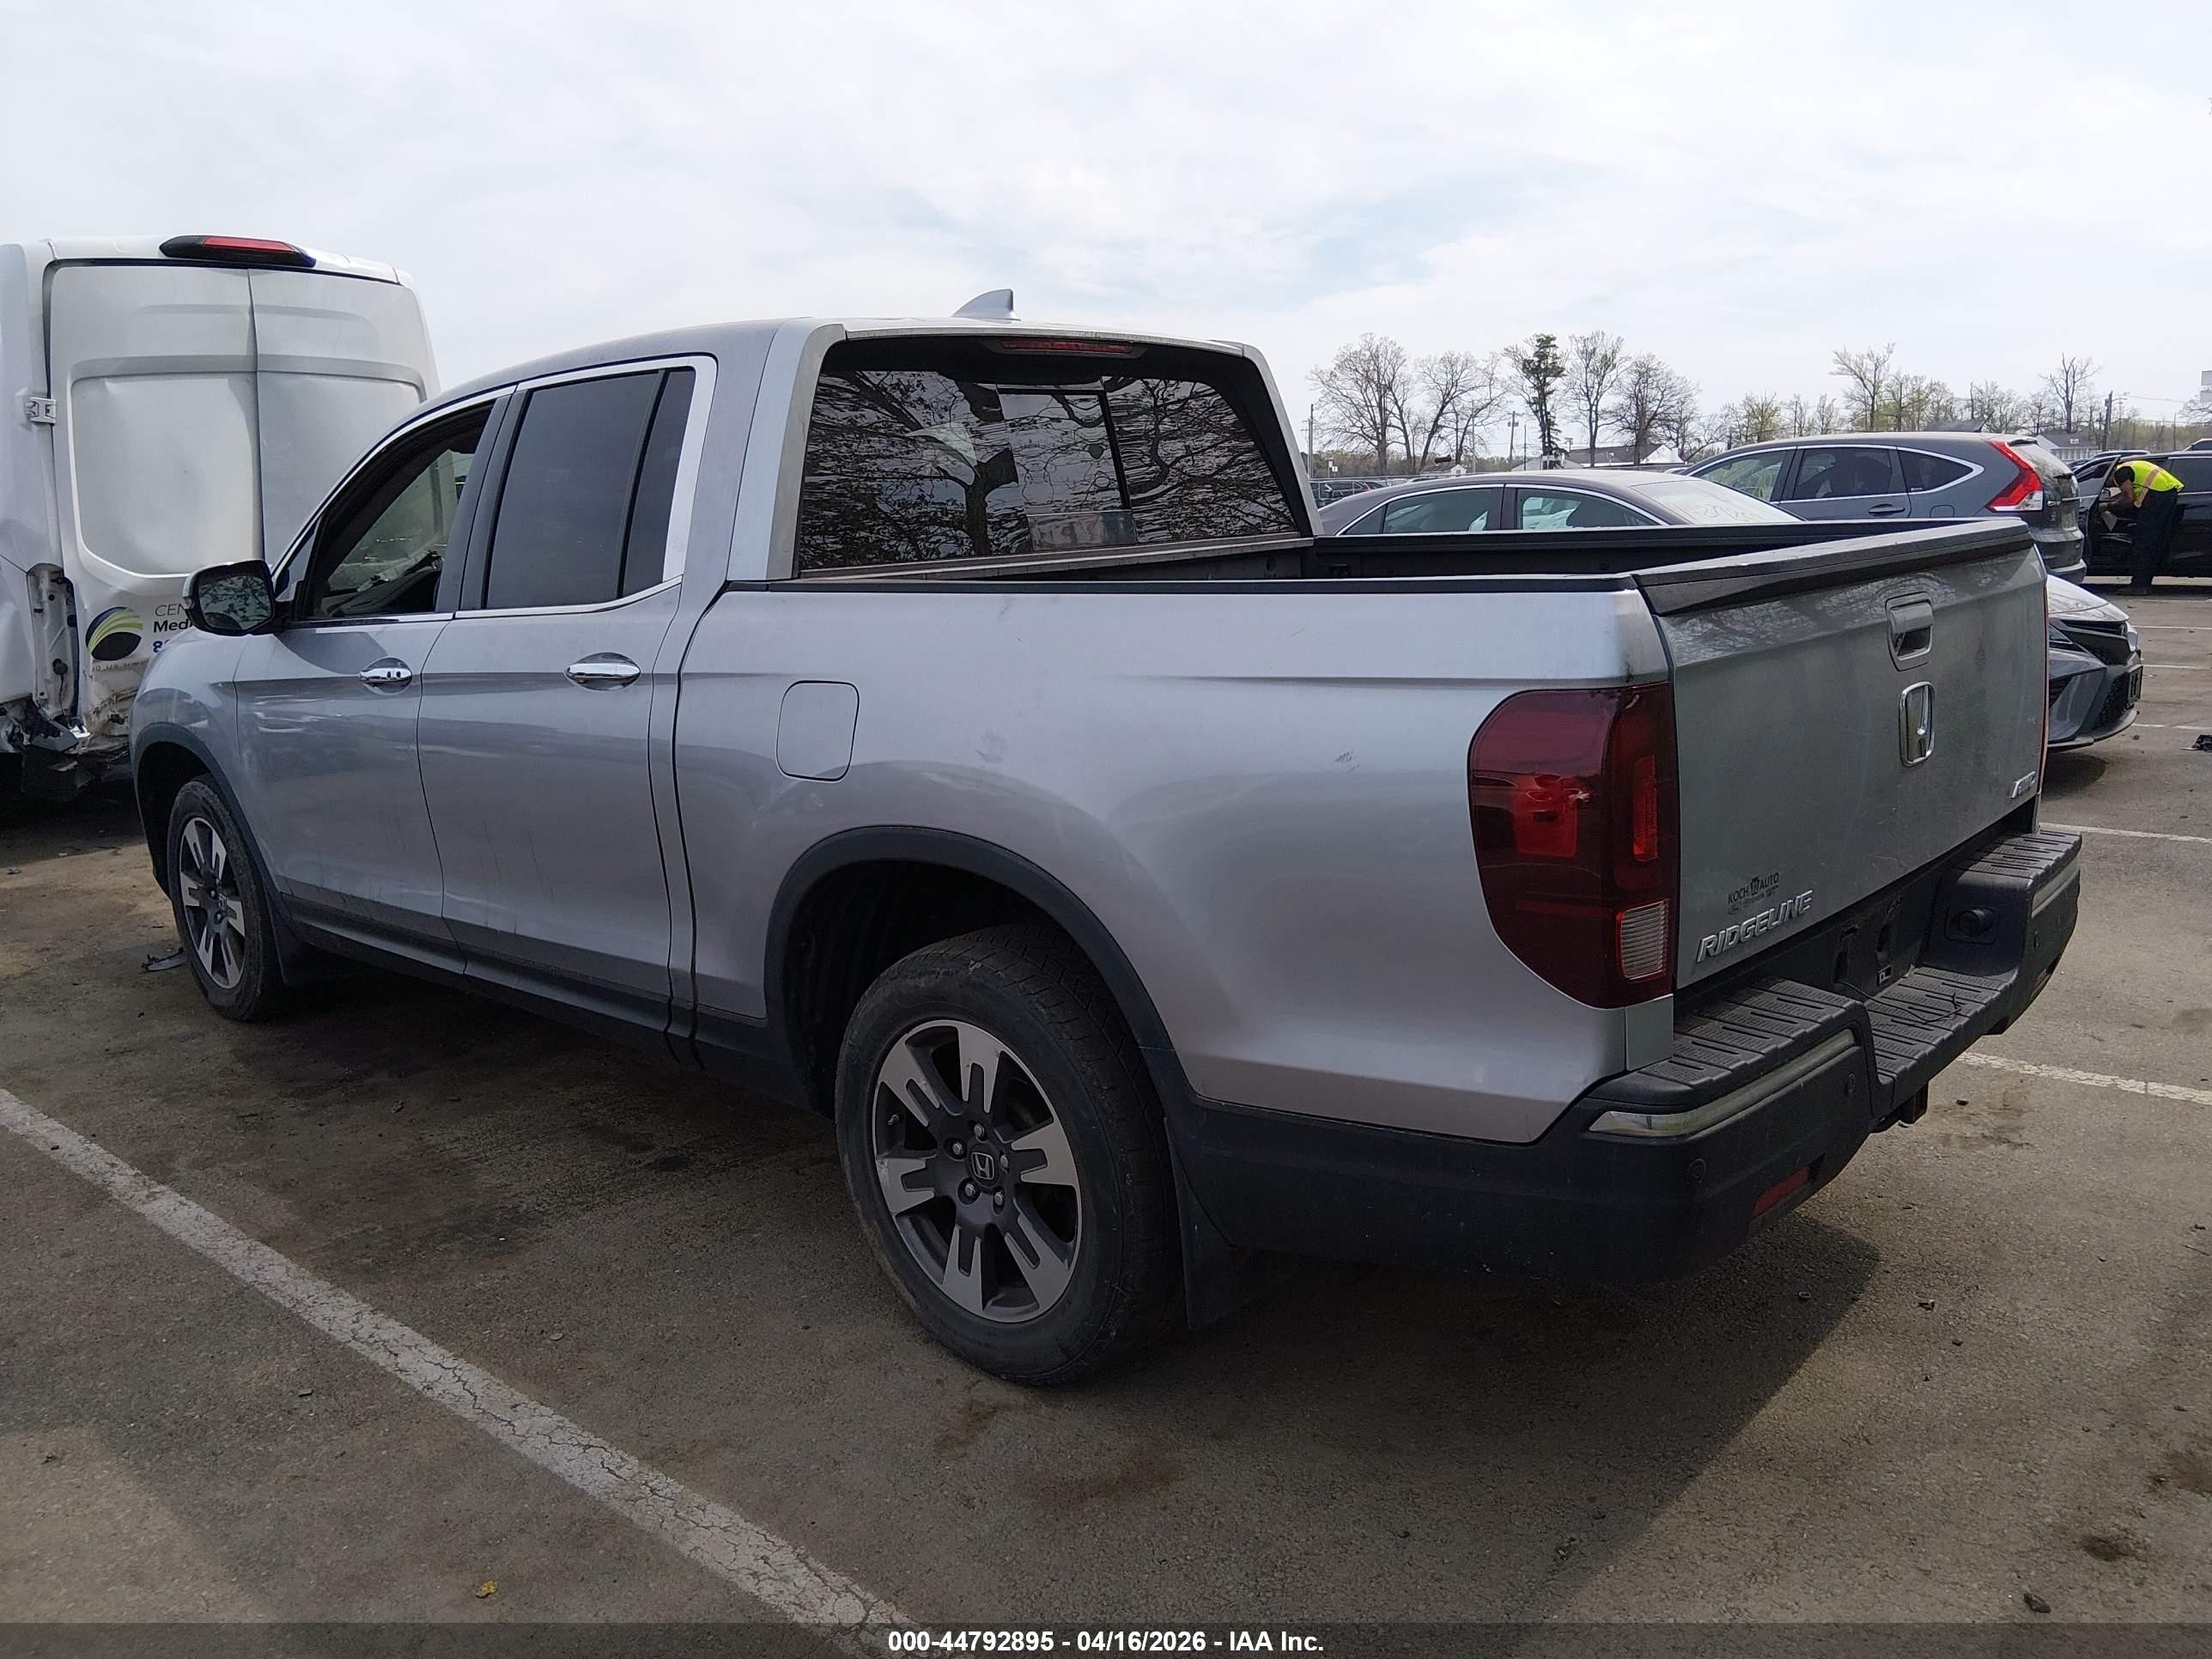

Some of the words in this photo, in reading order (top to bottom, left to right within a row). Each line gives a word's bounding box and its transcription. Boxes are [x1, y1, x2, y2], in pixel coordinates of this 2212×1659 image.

[1728, 885, 1749, 905] KOCH
[1759, 872, 1779, 890] AUTO
[1696, 890, 1813, 963] RIDGELINE
